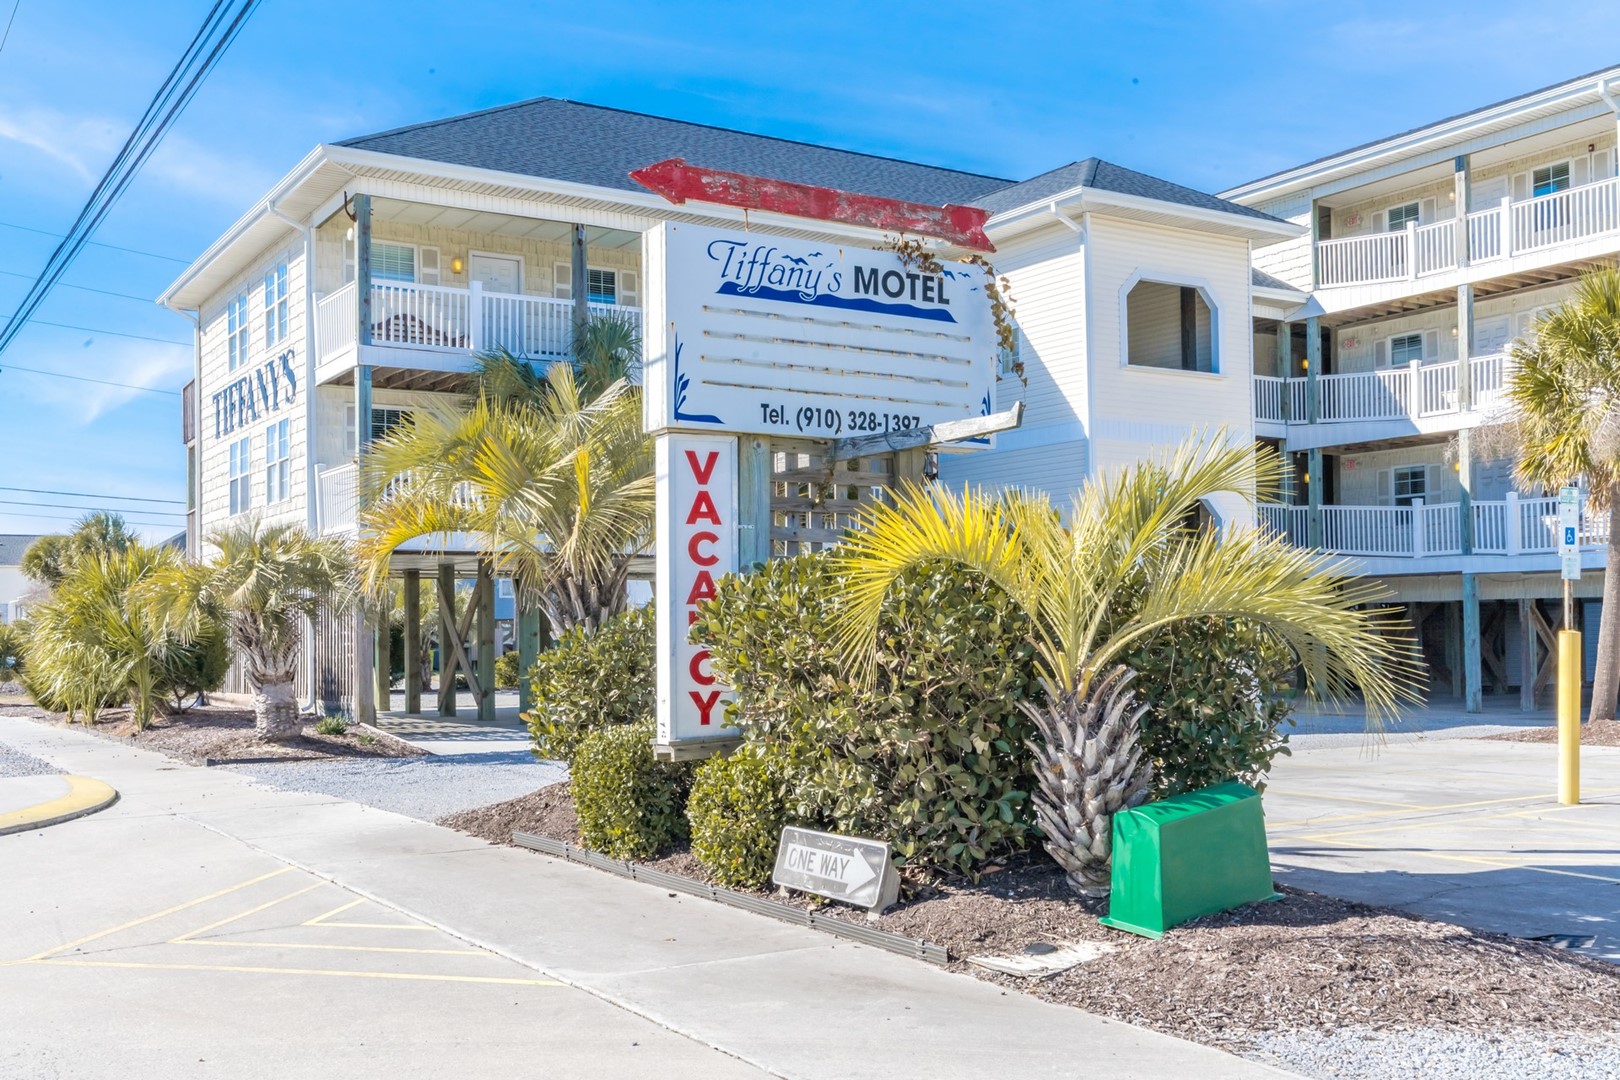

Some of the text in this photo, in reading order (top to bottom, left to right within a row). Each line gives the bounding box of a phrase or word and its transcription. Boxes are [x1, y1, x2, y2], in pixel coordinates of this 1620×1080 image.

[707, 239, 950, 305] Tiffany's MOTEL
[212, 349, 296, 439] TIFFANY'S
[760, 403, 920, 435] Tel. (910) 328-1397
[788, 847, 850, 880] ONE WAY
